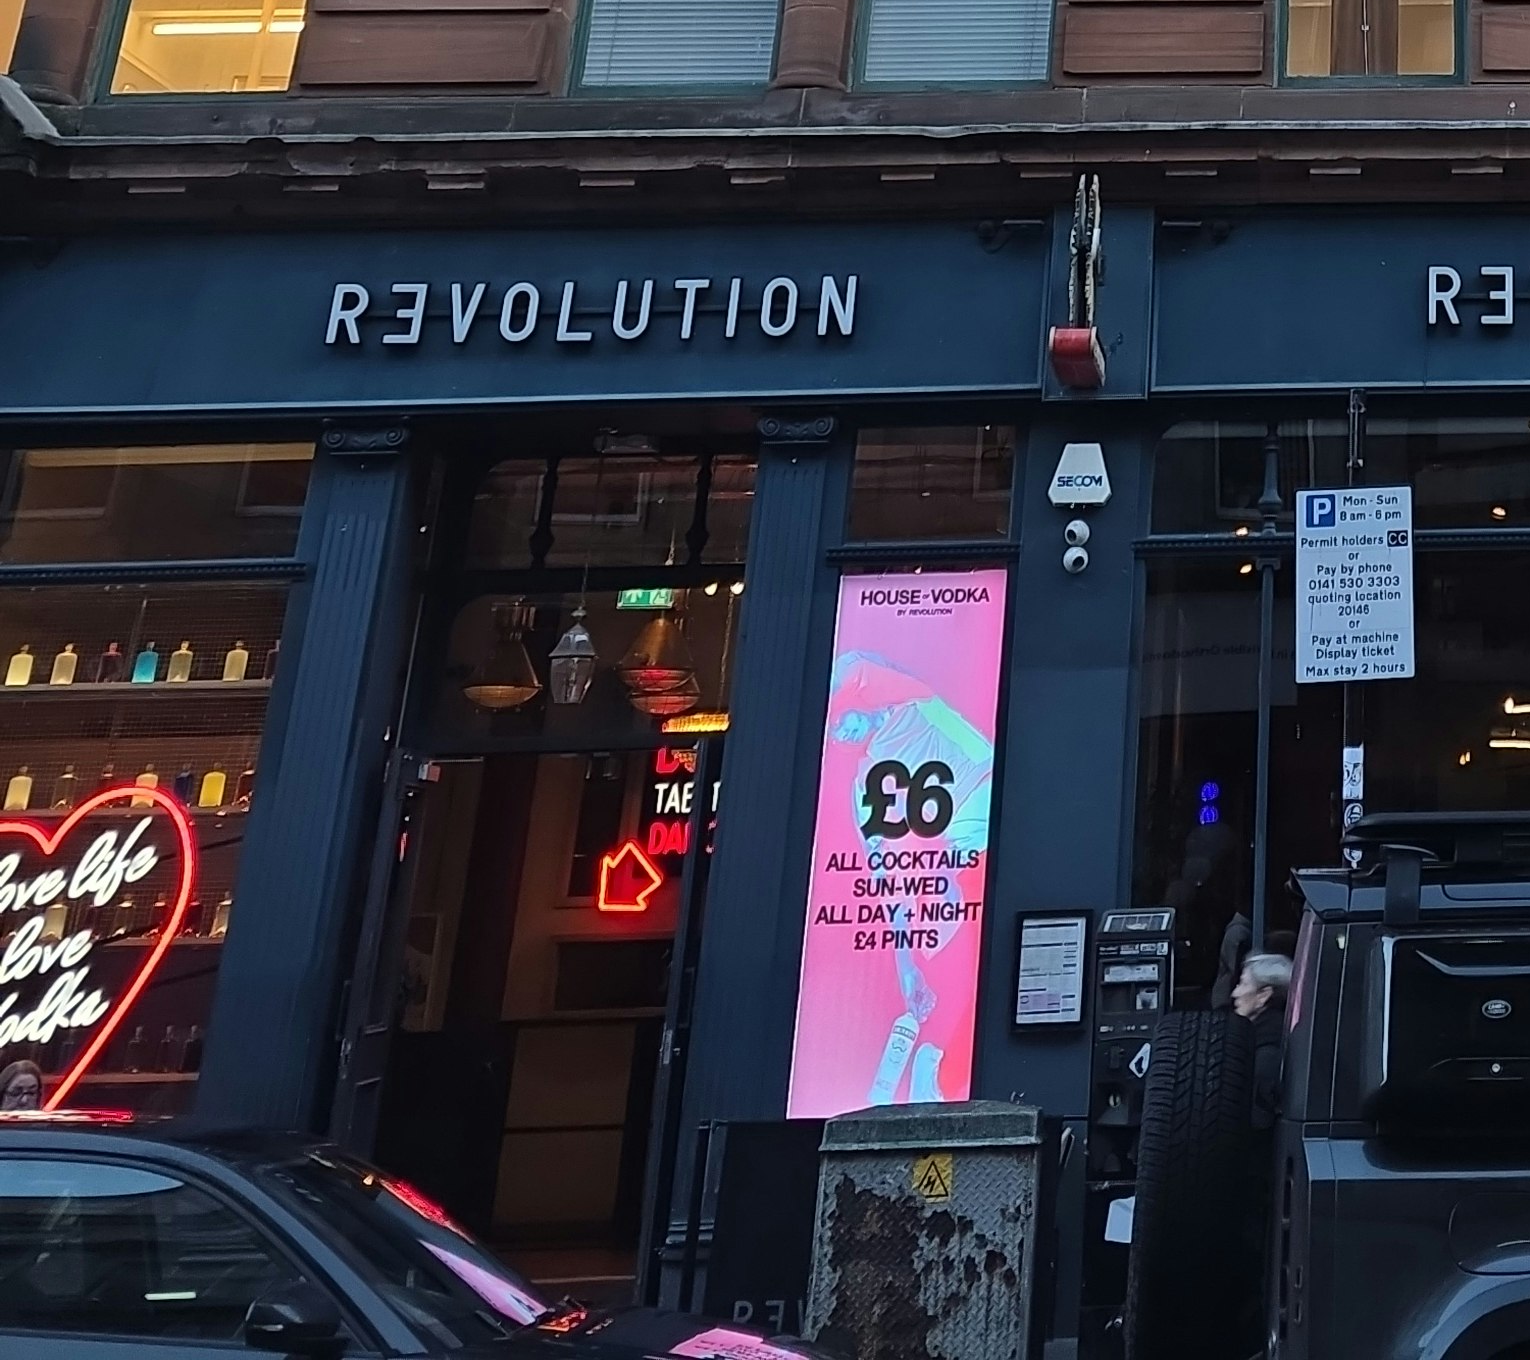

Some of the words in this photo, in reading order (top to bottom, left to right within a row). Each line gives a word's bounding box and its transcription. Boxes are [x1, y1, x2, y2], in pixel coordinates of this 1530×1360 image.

[325, 275, 857, 344] REVOLUTION
[1057, 475, 1103, 488] SECOM
[1343, 496, 1367, 506] Mon
[1376, 495, 1398, 505] Sun
[1350, 512, 1366, 521] am
[1385, 511, 1401, 522] pm
[1301, 536, 1338, 548] Permit
[1342, 535, 1384, 546] holders
[1388, 532, 1408, 545] CC
[1348, 552, 1359, 561] or
[1317, 565, 1336, 577] Pay
[1341, 564, 1353, 576] by
[1359, 562, 1392, 574] phone
[1309, 579, 1335, 590] 0141
[1340, 577, 1363, 589] 530
[1368, 576, 1400, 587] 3303
[860, 590, 922, 606] HOUSE
[930, 587, 990, 603] VODKA
[1308, 591, 1351, 604] quoting
[1355, 589, 1401, 601] location
[909, 608, 953, 616] REVOLUTION
[1349, 620, 1360, 629] or
[1312, 635, 1331, 647] Pay
[1336, 634, 1346, 644] at
[1352, 632, 1399, 643] machine
[1316, 648, 1358, 660] Display
[1362, 645, 1394, 657] ticket
[1306, 666, 1329, 676] Max
[1334, 665, 1356, 676] stay
[1362, 663, 1369, 673] 2
[1373, 662, 1405, 673] hours
[860, 759, 954, 840] £6
[67, 816, 159, 907] life
[826, 852, 862, 872] ALL
[868, 850, 979, 871] COCKTAILS
[853, 877, 948, 897] SUN-WED
[815, 905, 852, 924] ALL
[858, 904, 900, 924] DAY
[920, 902, 981, 922] NIGHT
[854, 931, 876, 950] £4
[882, 930, 938, 949] PINTS
[0, 915, 93, 985] love
